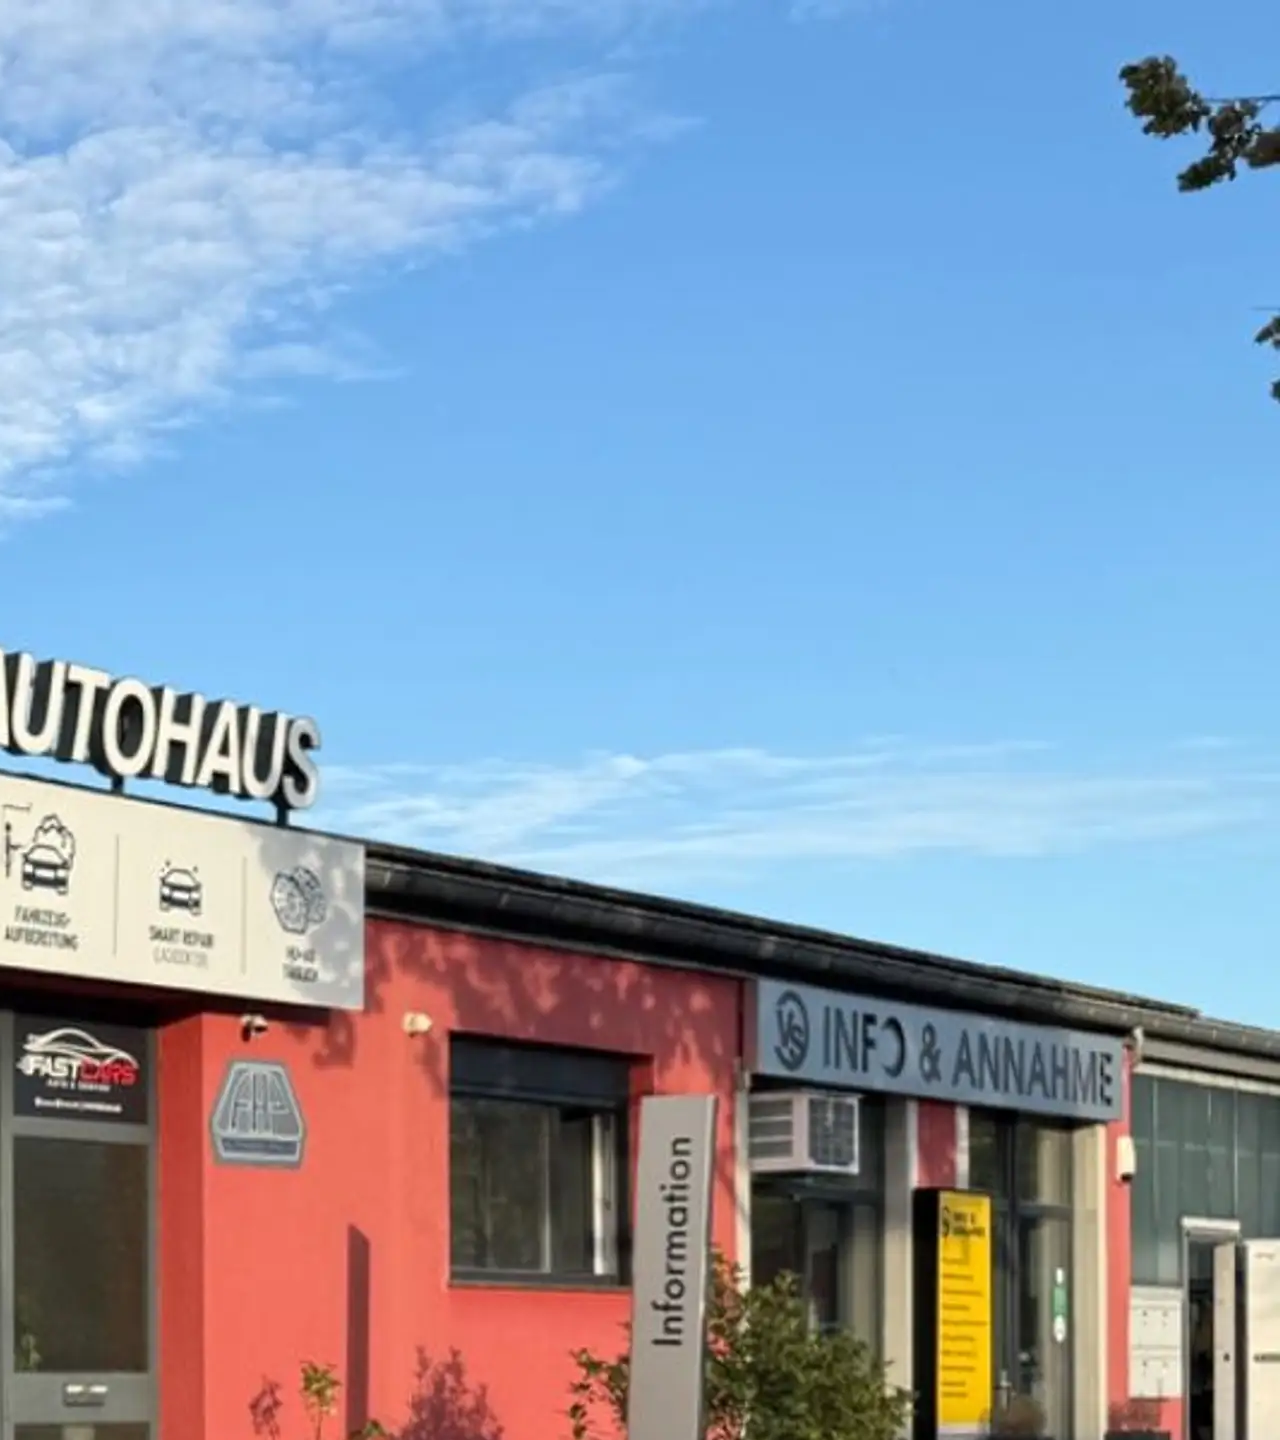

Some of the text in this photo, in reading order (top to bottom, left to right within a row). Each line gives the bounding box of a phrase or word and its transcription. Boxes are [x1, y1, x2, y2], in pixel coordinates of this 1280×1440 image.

[920, 1021, 942, 1084] &
[951, 1029, 1115, 1108] ANNAHME
[650, 1136, 692, 1346] Information
